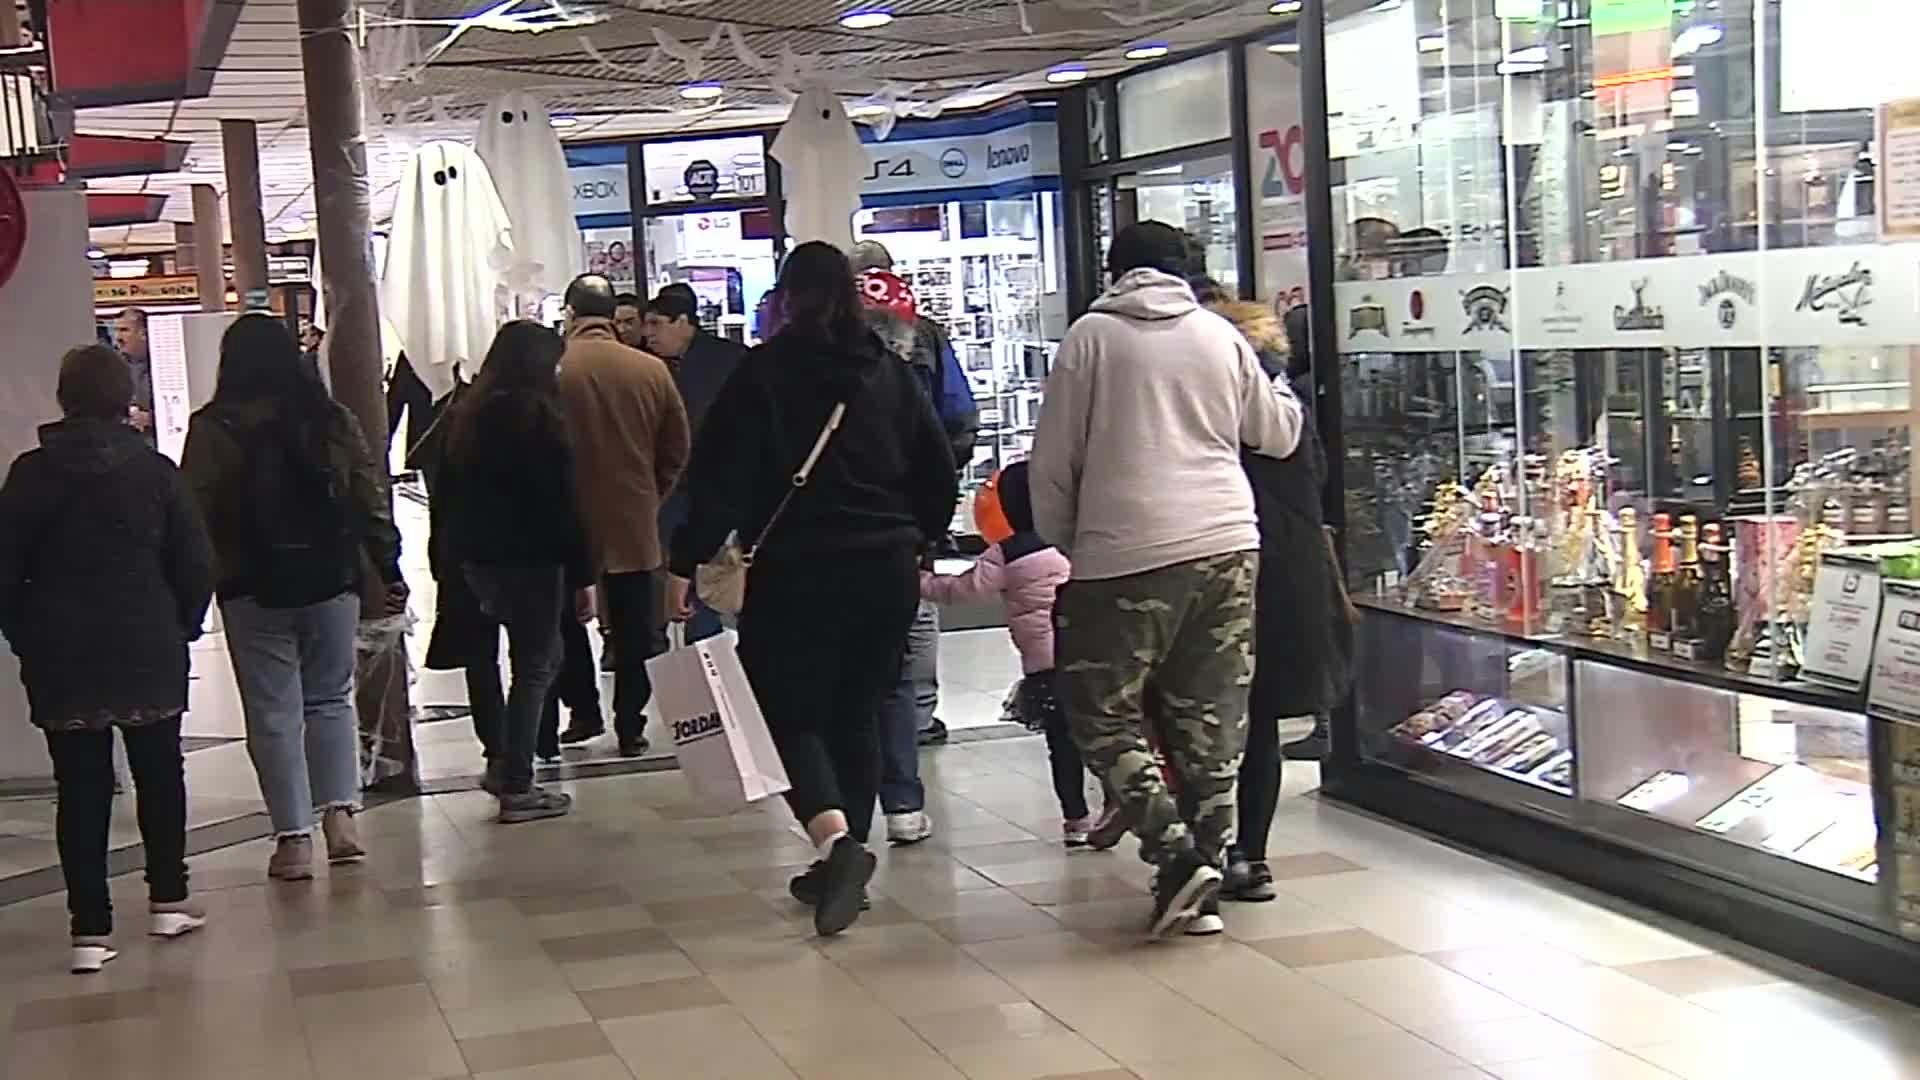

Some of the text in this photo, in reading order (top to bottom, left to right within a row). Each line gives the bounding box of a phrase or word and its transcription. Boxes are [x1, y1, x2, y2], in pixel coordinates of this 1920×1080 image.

[986, 143, 1030, 170] lenovo
[863, 158, 916, 181] S4
[573, 180, 617, 199] XBOX
[713, 216, 731, 229] LG
[672, 711, 722, 740] JORDA
